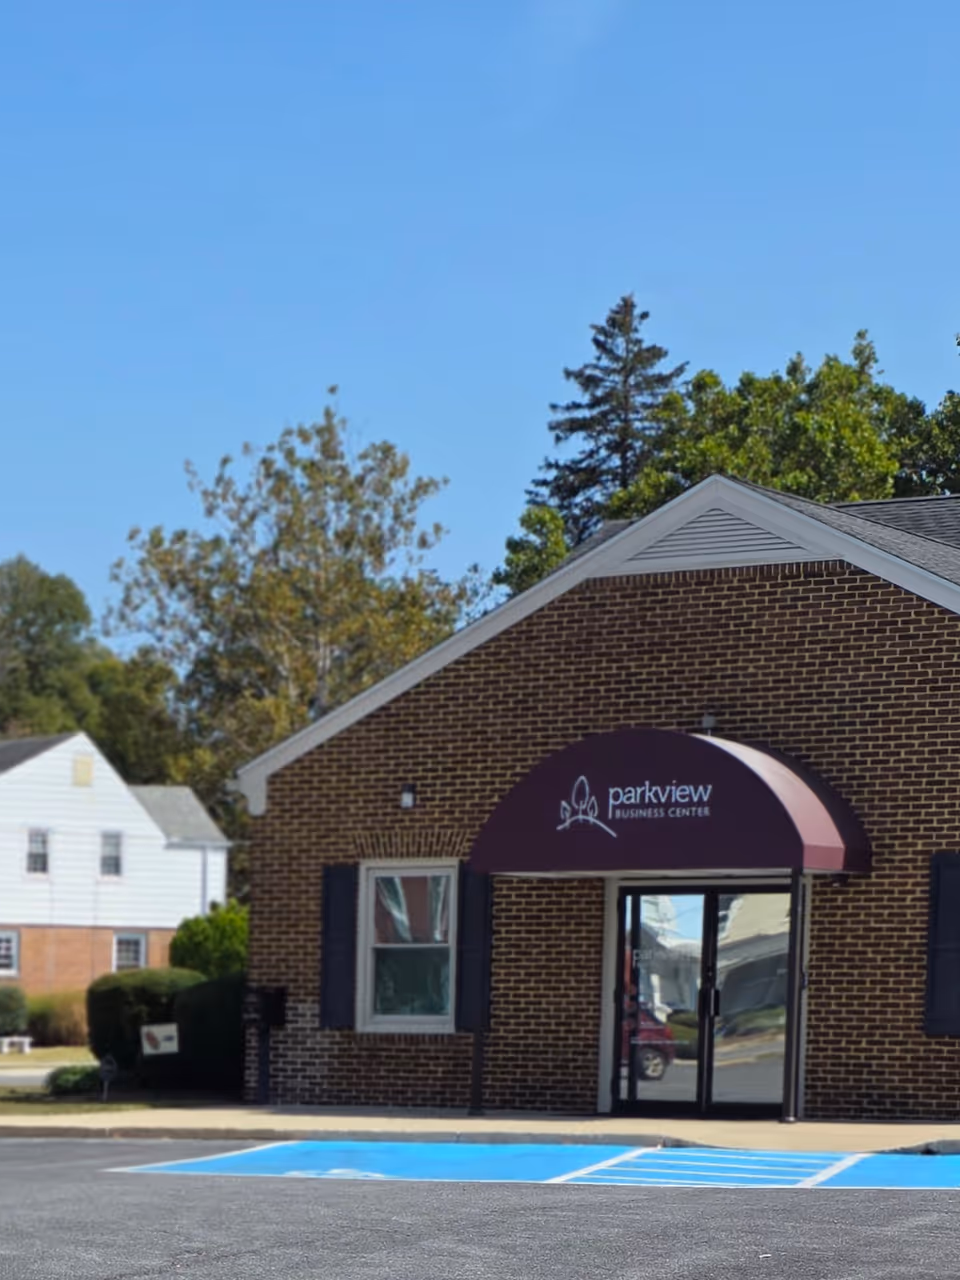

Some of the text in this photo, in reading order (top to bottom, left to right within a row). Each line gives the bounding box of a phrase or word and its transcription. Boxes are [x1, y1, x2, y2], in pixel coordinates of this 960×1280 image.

[608, 779, 713, 819] parkview
[615, 806, 710, 819] BUSINESS CENTER
